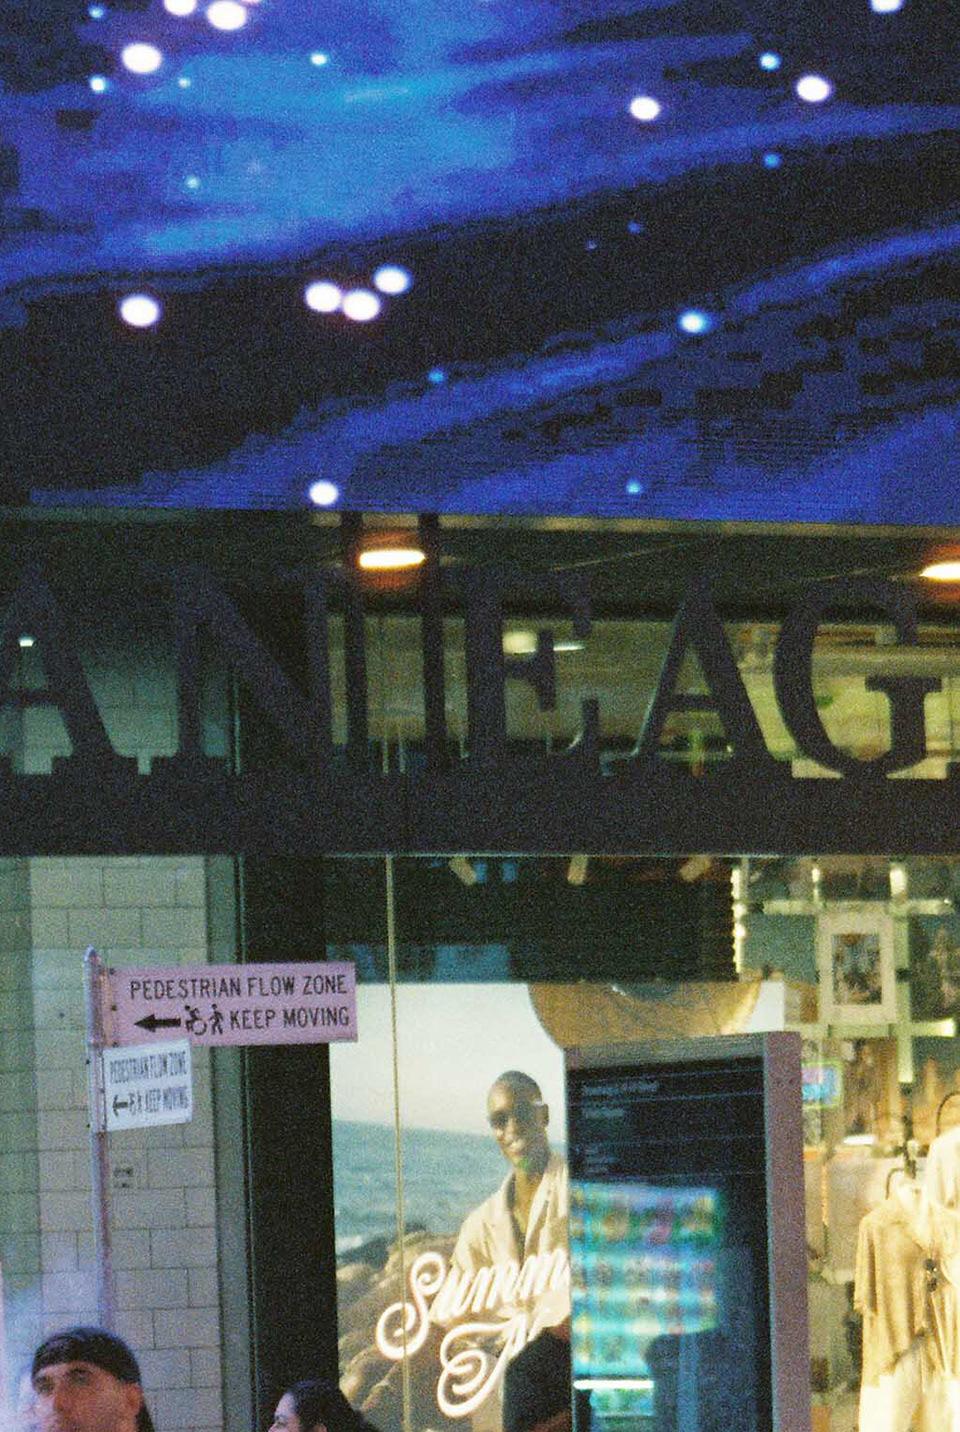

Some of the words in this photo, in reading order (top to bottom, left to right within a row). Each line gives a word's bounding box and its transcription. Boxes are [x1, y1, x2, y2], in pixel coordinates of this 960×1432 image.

[130, 977, 241, 1000] PEDESTRIAN
[247, 975, 295, 997] FLOW
[302, 974, 348, 995] ZONE
[229, 1008, 276, 1030] KEEP
[283, 1006, 349, 1029] MOVING
